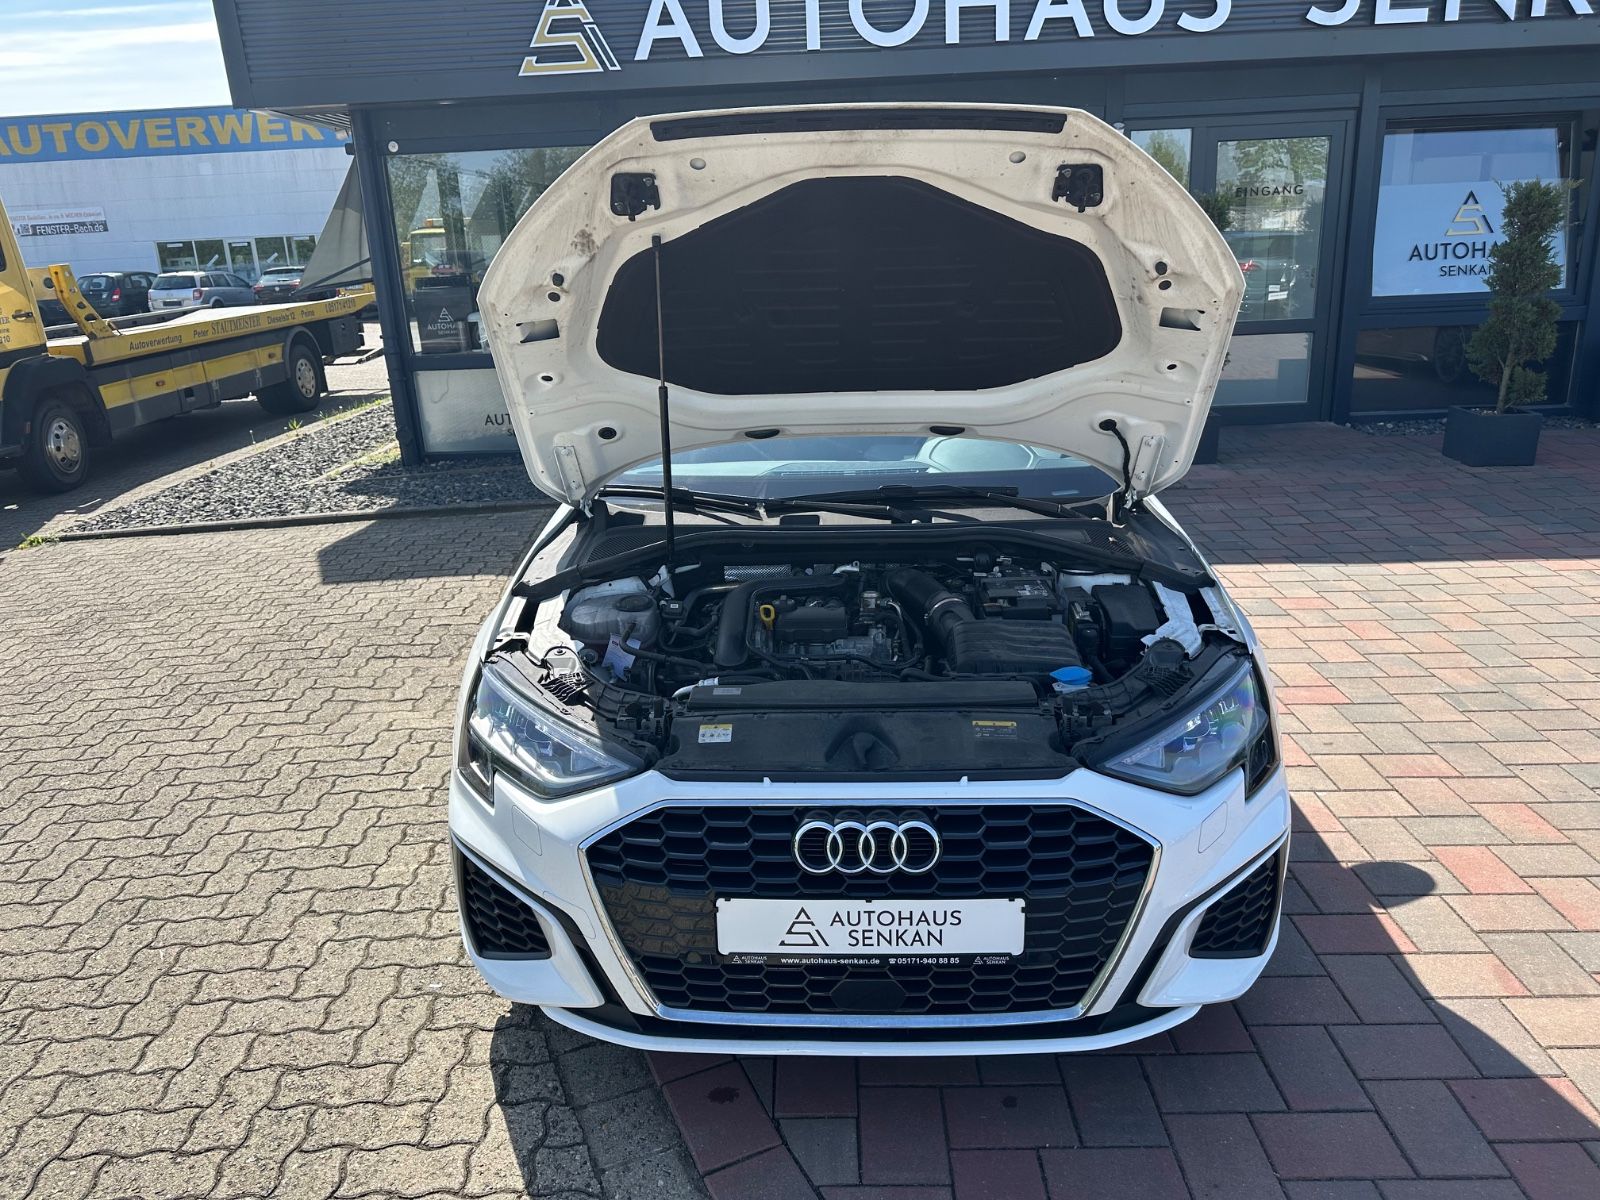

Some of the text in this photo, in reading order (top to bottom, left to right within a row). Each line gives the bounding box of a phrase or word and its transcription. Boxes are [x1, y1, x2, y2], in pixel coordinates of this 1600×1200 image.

[1235, 184, 1304, 198] EINGANG
[129, 334, 183, 352] Autoverwertung
[193, 329, 209, 340] Peter
[485, 413, 512, 426] AUT
[830, 910, 962, 927] AUTOHAUS
[848, 929, 943, 947] SENKAN
[780, 957, 880, 965] www.autohaus-senkan.de
[897, 957, 960, 965] 05171-940 88 85
